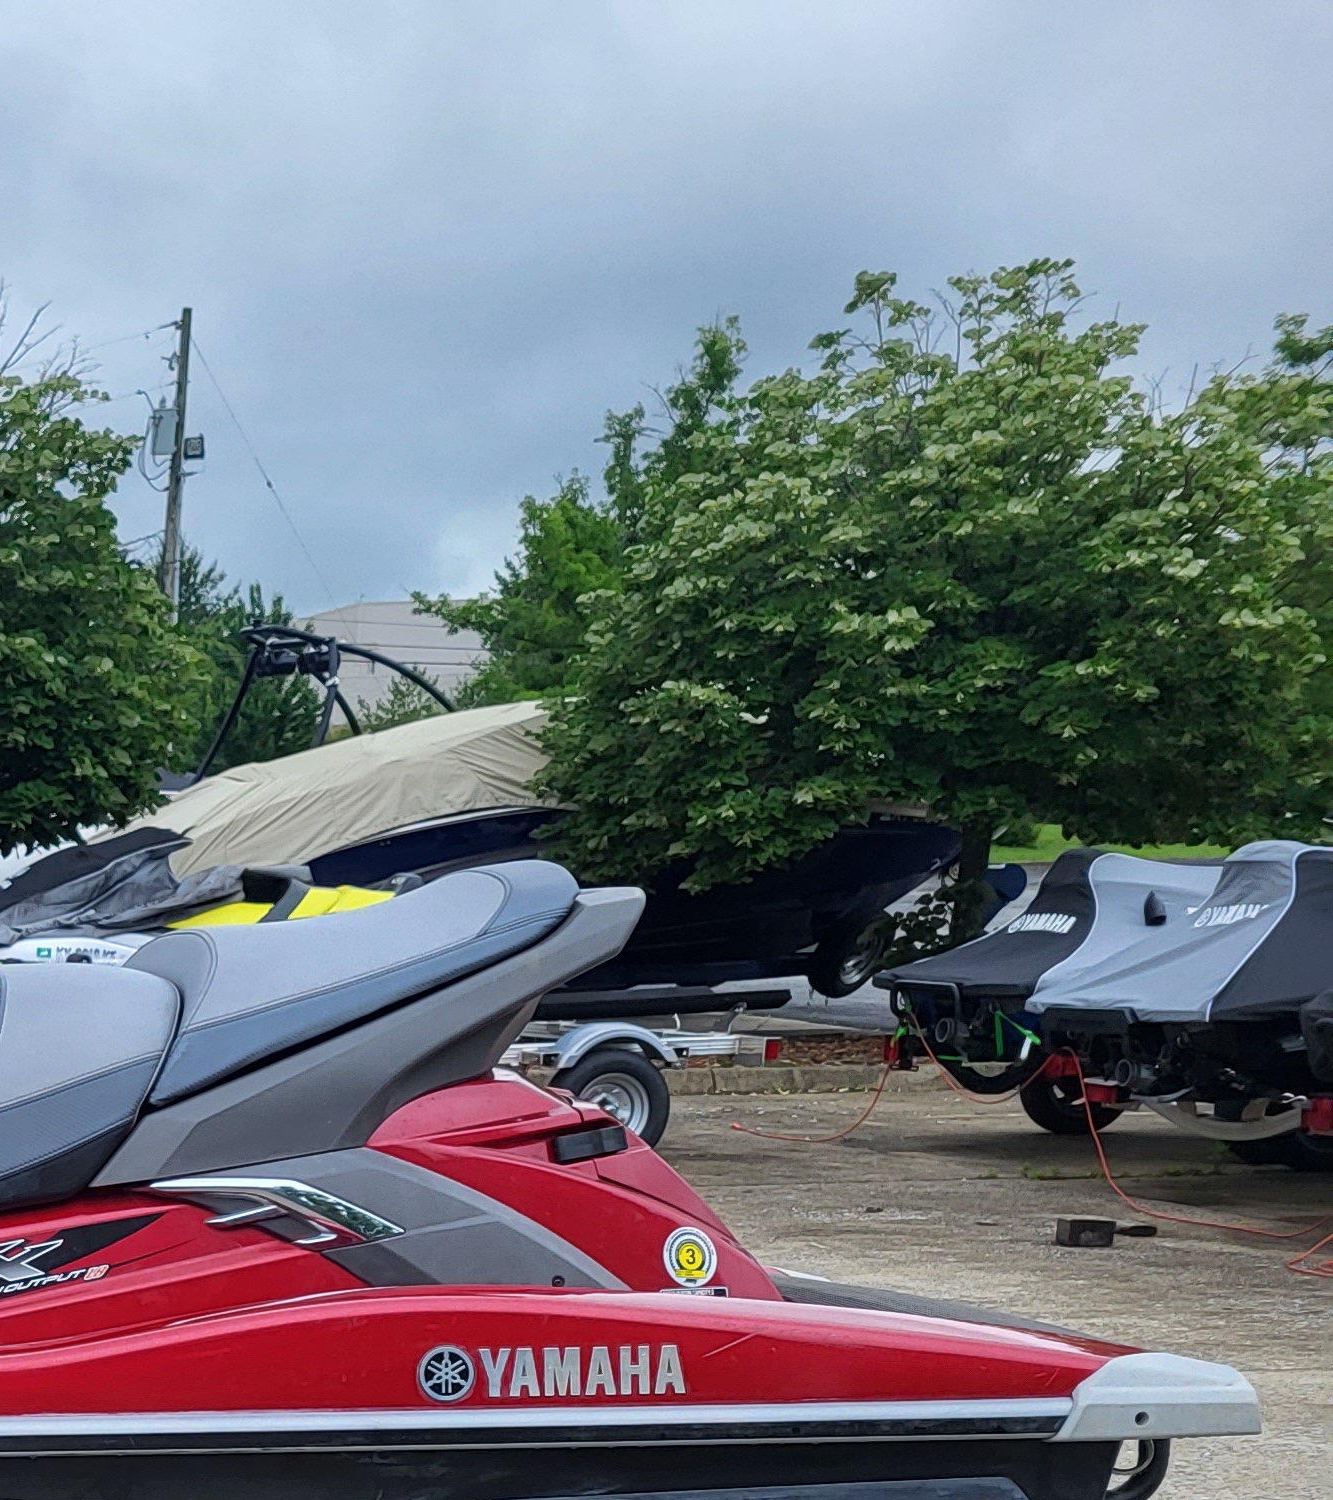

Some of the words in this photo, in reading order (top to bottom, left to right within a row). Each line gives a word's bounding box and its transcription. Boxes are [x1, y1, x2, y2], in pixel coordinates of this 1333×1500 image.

[1020, 912, 1077, 934] YAMAHA
[685, 1248, 696, 1265] 3
[478, 1345, 686, 1398] YAMAHA
